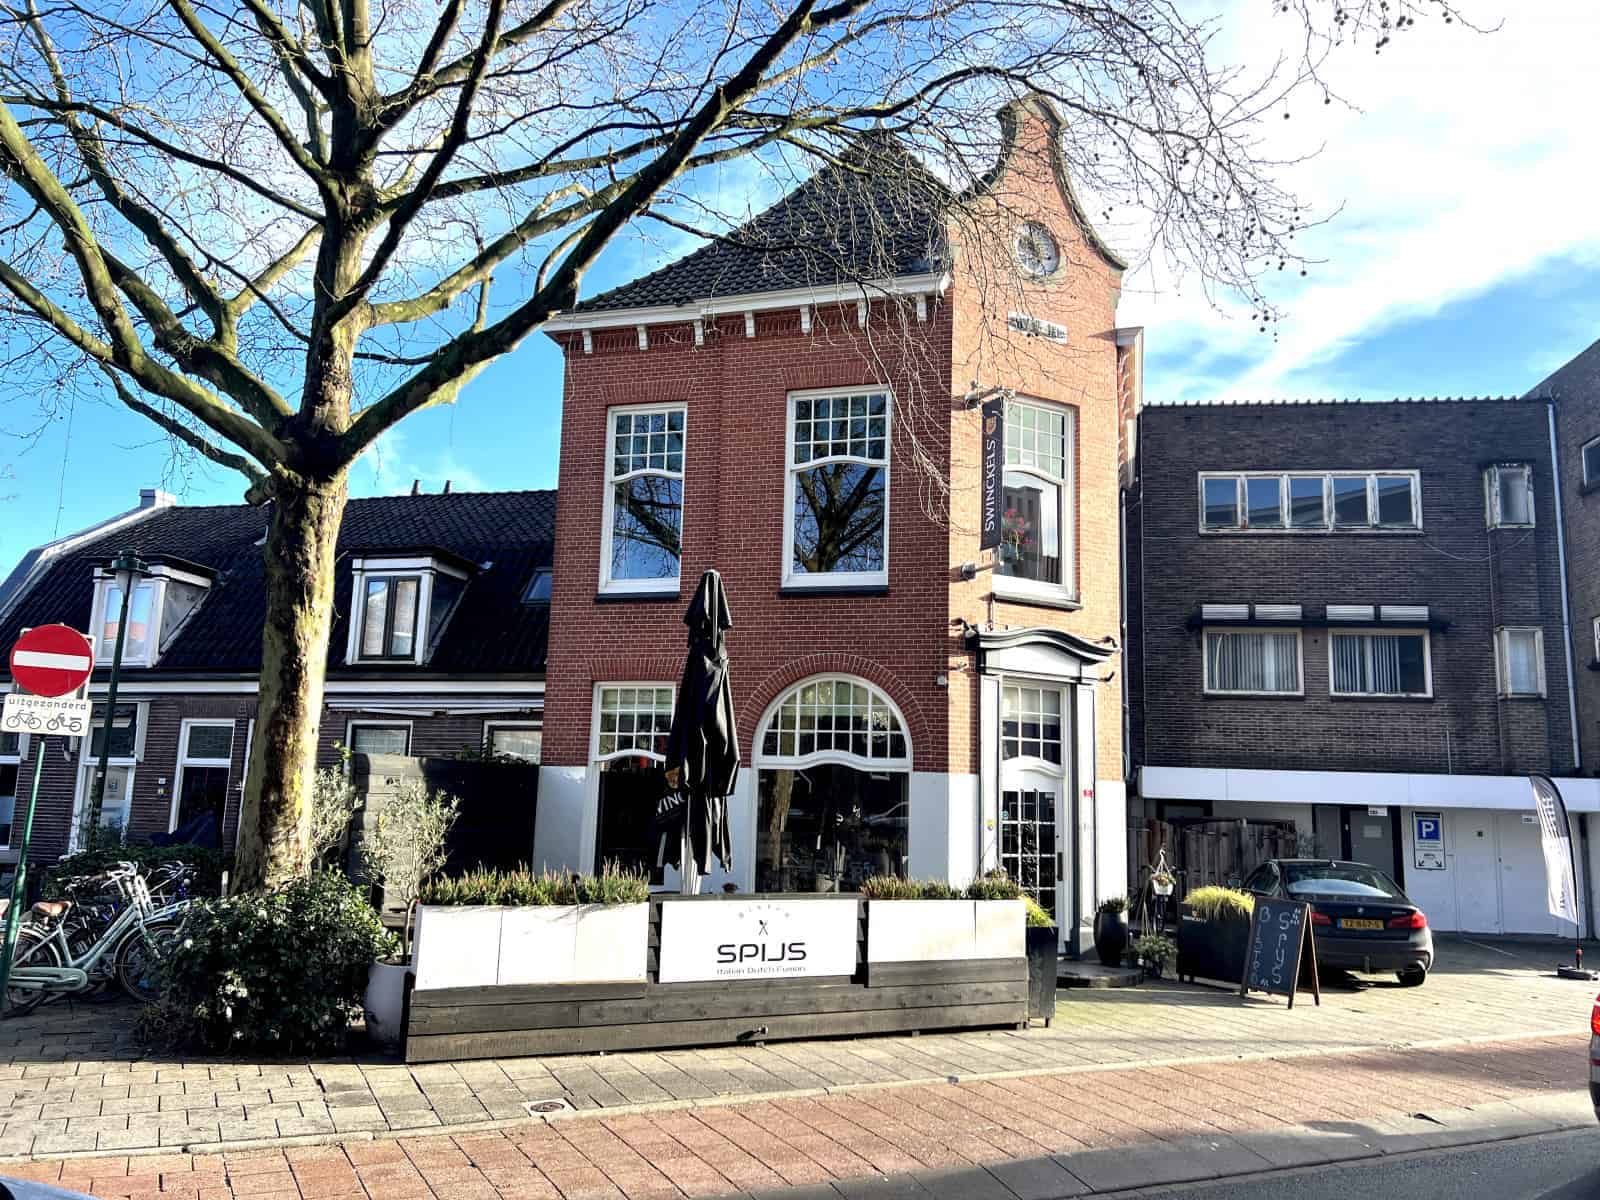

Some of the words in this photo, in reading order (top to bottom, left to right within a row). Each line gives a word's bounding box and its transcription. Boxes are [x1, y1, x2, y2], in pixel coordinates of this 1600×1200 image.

[985, 439, 996, 532] SWINCKELS
[8, 697, 87, 710] uitgezonderd
[1421, 821, 1434, 838] P
[716, 942, 807, 963] SPIJS
[716, 967, 745, 976] Italian
[747, 966, 775, 975] Dutch
